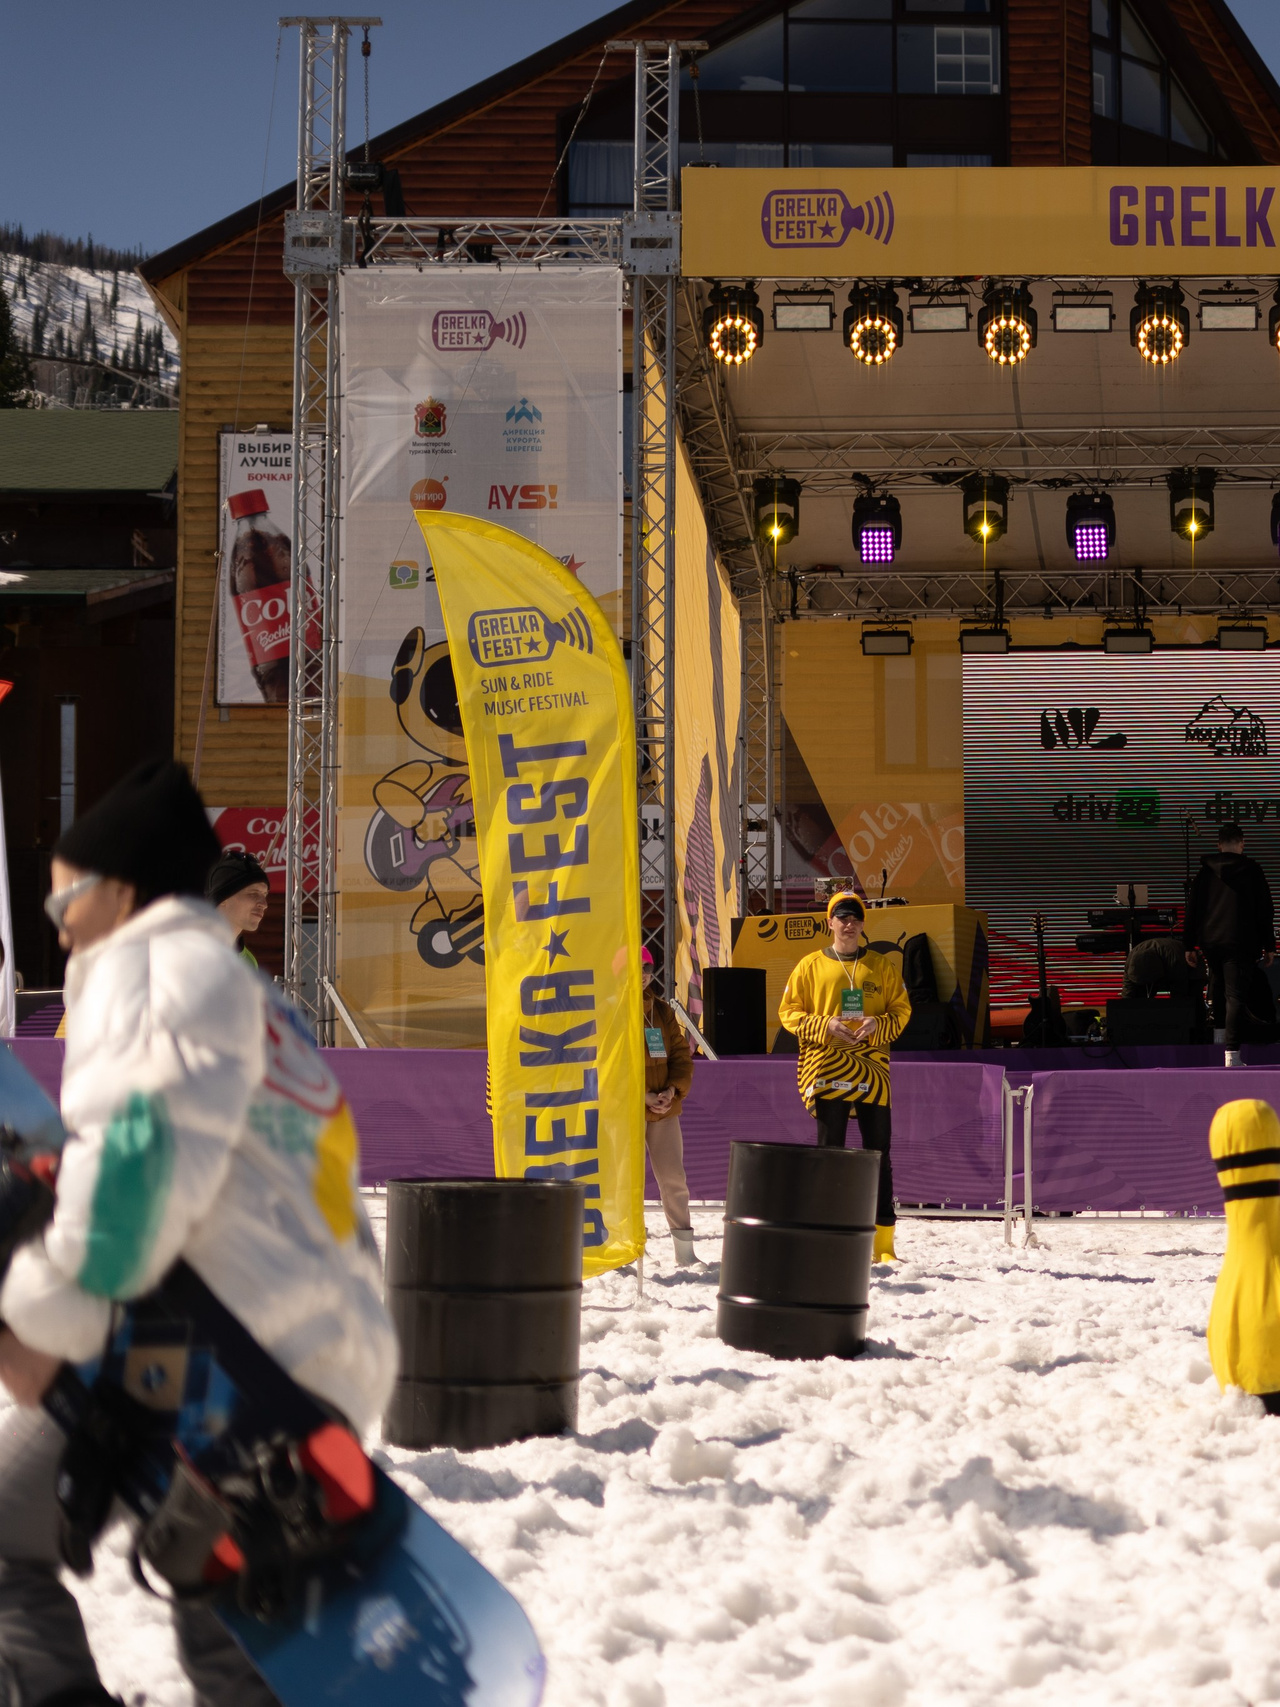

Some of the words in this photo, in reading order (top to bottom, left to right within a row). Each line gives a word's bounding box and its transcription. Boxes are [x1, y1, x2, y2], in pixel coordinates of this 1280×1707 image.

[775, 197, 838, 217] GRELKA
[775, 220, 817, 240] FEST
[441, 316, 486, 329] GRELKA
[441, 331, 471, 345] FEST
[502, 428, 546, 436] ДИРЕКЦИЯ
[238, 443, 298, 454] ВЫБИР
[247, 473, 302, 482] БОЧКАР
[414, 492, 444, 503] энгиро
[488, 484, 558, 510] AYS!
[479, 614, 540, 638] GRELKA
[482, 636, 523, 660] FEST
[480, 676, 508, 694] SUN
[510, 676, 521, 690] &
[523, 671, 554, 689] RIDE
[484, 697, 527, 716] MUSIC
[529, 691, 589, 712] FESTIVAL
[497, 733, 591, 923] FEST
[789, 920, 812, 928] GRELKA
[789, 928, 805, 937] FEST
